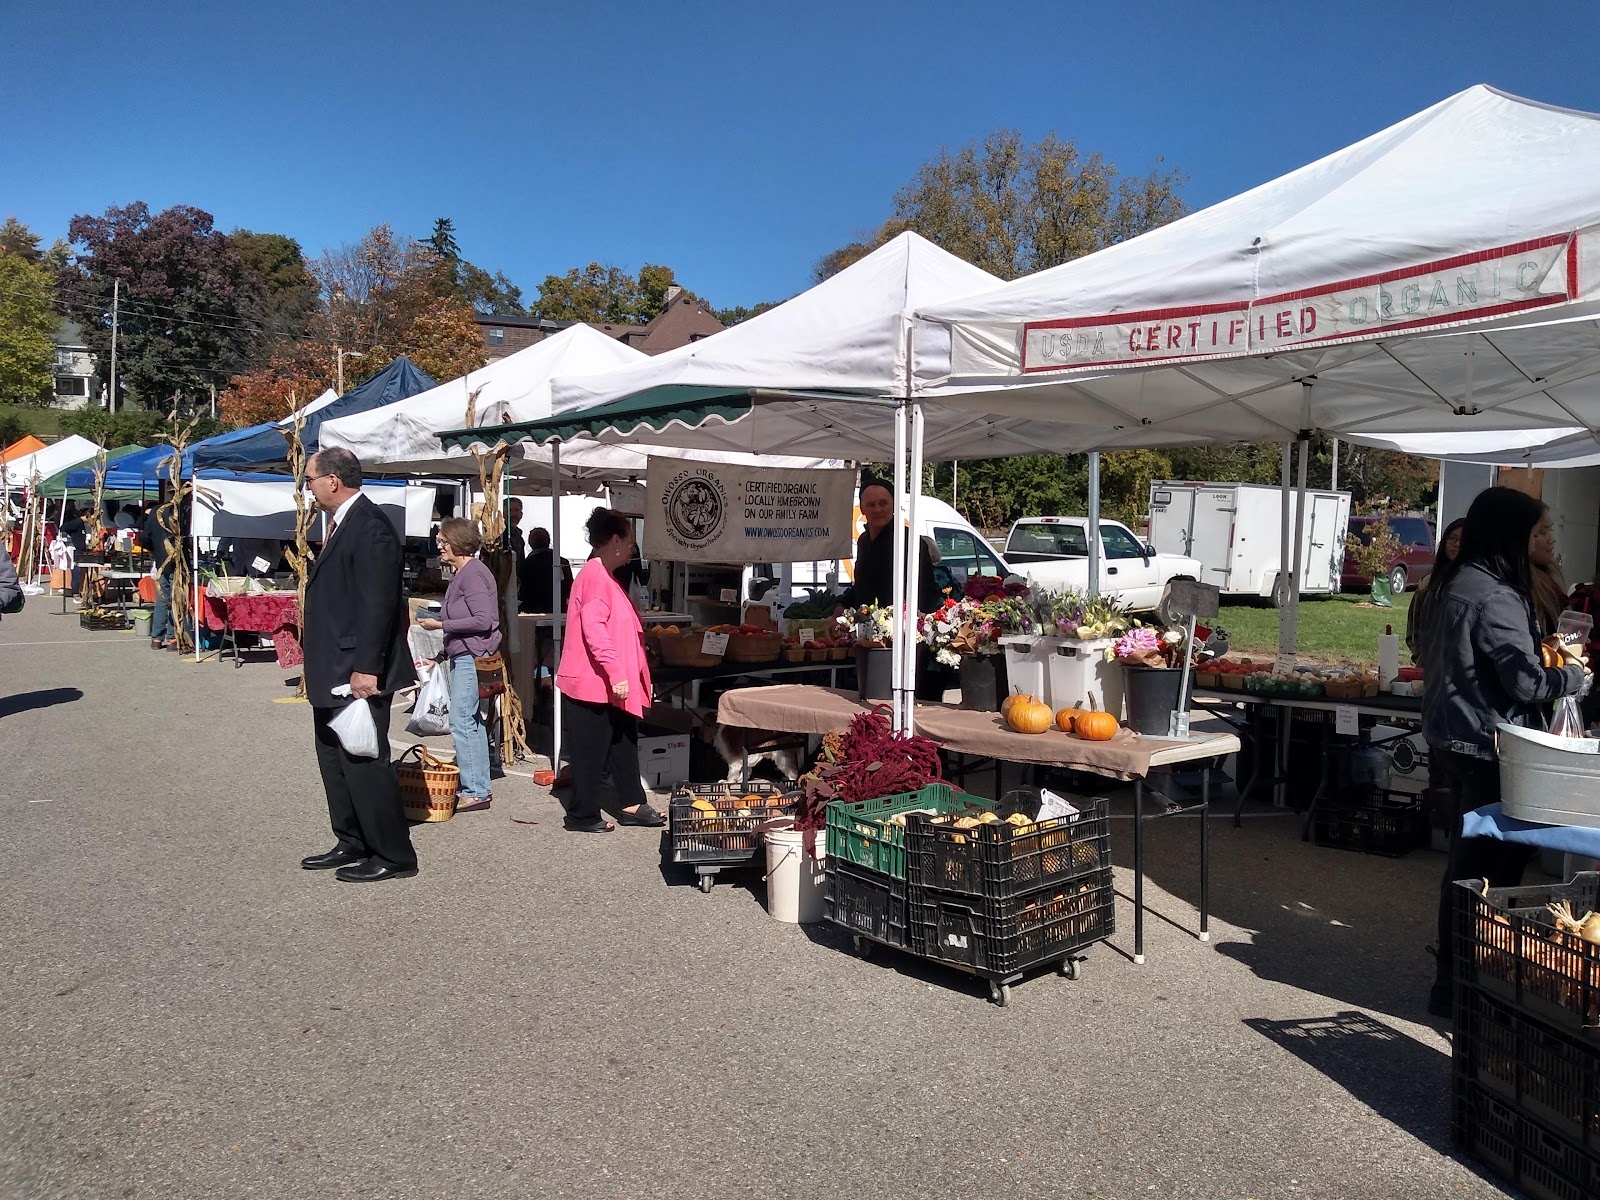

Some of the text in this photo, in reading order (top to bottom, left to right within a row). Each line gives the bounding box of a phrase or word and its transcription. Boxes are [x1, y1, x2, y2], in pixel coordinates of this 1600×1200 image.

[1042, 261, 1539, 358] USDA CERTIFIED ORGANIC
[661, 468, 729, 508] OWOSSO ORGANICS
[745, 481, 817, 494] CERTIFIED ORGANIC
[744, 494, 775, 506] LOCALLY
[744, 508, 756, 519] ON
[759, 508, 774, 519] OUR
[799, 509, 819, 520] FARM
